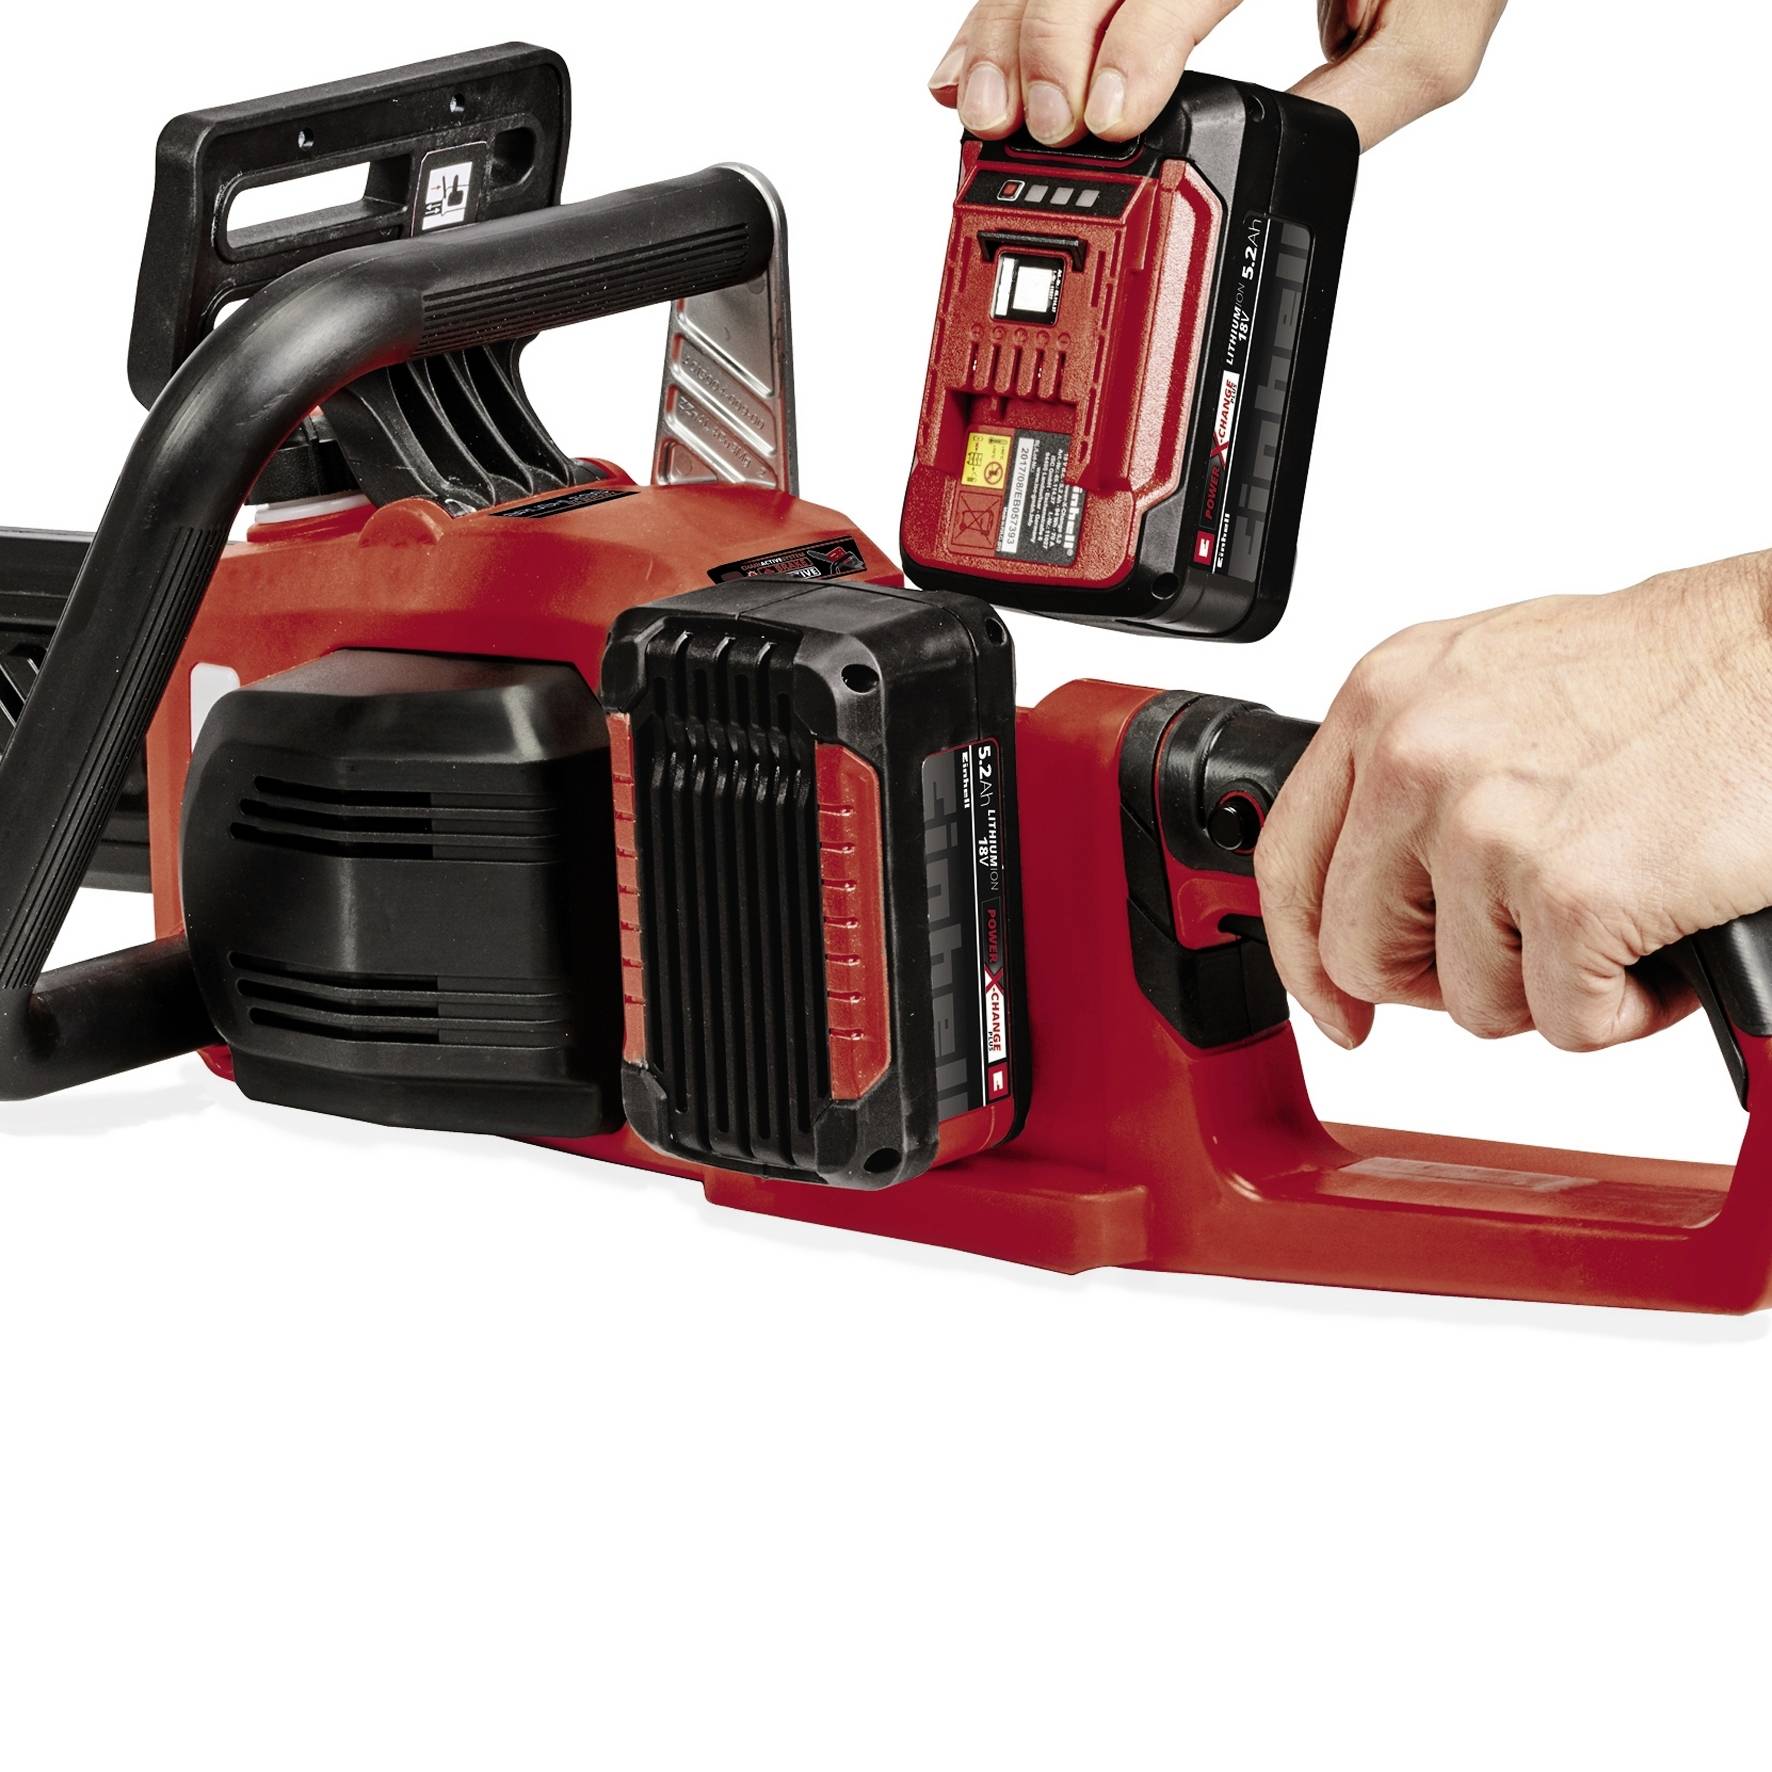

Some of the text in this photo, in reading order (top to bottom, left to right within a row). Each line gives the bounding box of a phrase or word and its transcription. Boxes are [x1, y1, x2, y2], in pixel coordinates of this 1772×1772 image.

[1241, 219, 1262, 280] 5.2Ah
[1237, 310, 1250, 340] 18V
[1230, 383, 1238, 403] PLUS
[1204, 379, 1234, 519] POWER X-CHANGE
[1006, 447, 1029, 545] 2017/08/EB057393
[1216, 512, 1231, 568] Einhell
[962, 751, 970, 808] Einhell
[978, 745, 993, 806] 5.2Ah
[978, 836, 989, 866] 18V
[984, 909, 1004, 1051] POWER X-CHANGE
